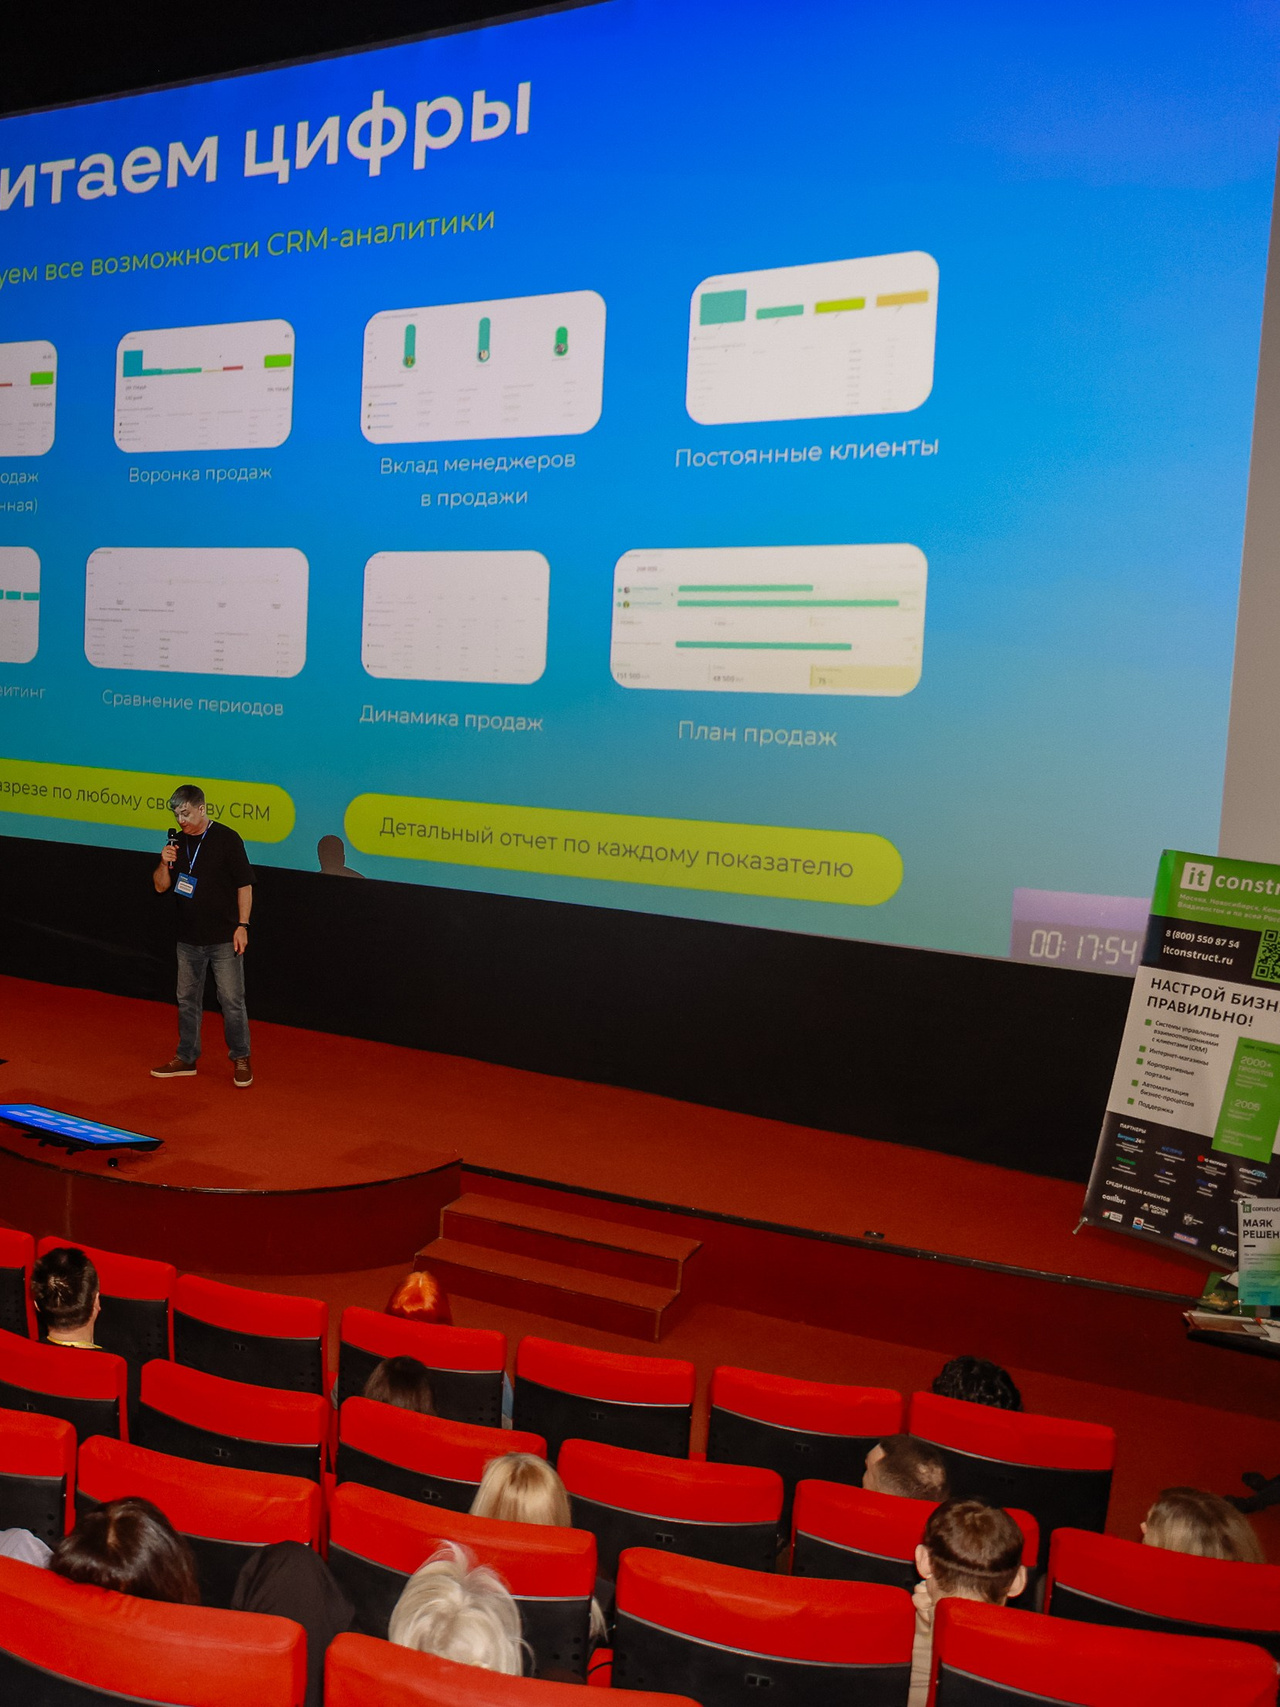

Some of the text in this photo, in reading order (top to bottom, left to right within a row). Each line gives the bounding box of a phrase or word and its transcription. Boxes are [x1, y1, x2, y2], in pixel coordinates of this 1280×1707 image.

[244, 81, 531, 184] цифры
[45, 260, 84, 281] все
[91, 241, 259, 276] возможности
[267, 210, 495, 257] CRM-аналитики
[380, 452, 576, 475] Вклад менеджеров
[675, 438, 939, 468] Постоянные клиенты
[129, 466, 273, 485] Воронка продаж
[421, 490, 528, 509] в продажи
[102, 688, 284, 717] Сравнение периодов
[359, 704, 544, 732] Динамика продаж
[678, 719, 838, 747] План продаж
[51, 785, 72, 800] по
[76, 786, 143, 812] любому
[229, 802, 270, 822] CRM
[379, 815, 854, 880] Детальный отчет по каждому показателю
[1187, 866, 1280, 896] it constr
[1165, 929, 1240, 949] 8 (800) 550 87 54
[1162, 944, 1234, 966] itconstruct.ru
[1150, 977, 1280, 1013] НАСТРОЙ БИЗН
[1146, 995, 1254, 1028] ПРАВИЛЬНО!
[1155, 1019, 1220, 1039] Системы управления
[1149, 1047, 1210, 1067] Интернет-магазины
[1156, 1039, 1189, 1050] клиентами
[1188, 1043, 1209, 1055] (CRM)
[1144, 1071, 1171, 1081] порталы
[1146, 1060, 1195, 1077] Корпоративные
[1139, 1088, 1195, 1108] бизнес-процессов
[1141, 1081, 1189, 1098] Автоматизация
[1137, 1100, 1174, 1115] Поддержка
[1242, 1218, 1273, 1229] МАЯК
[1242, 1230, 1280, 1240] РЕШЕН
